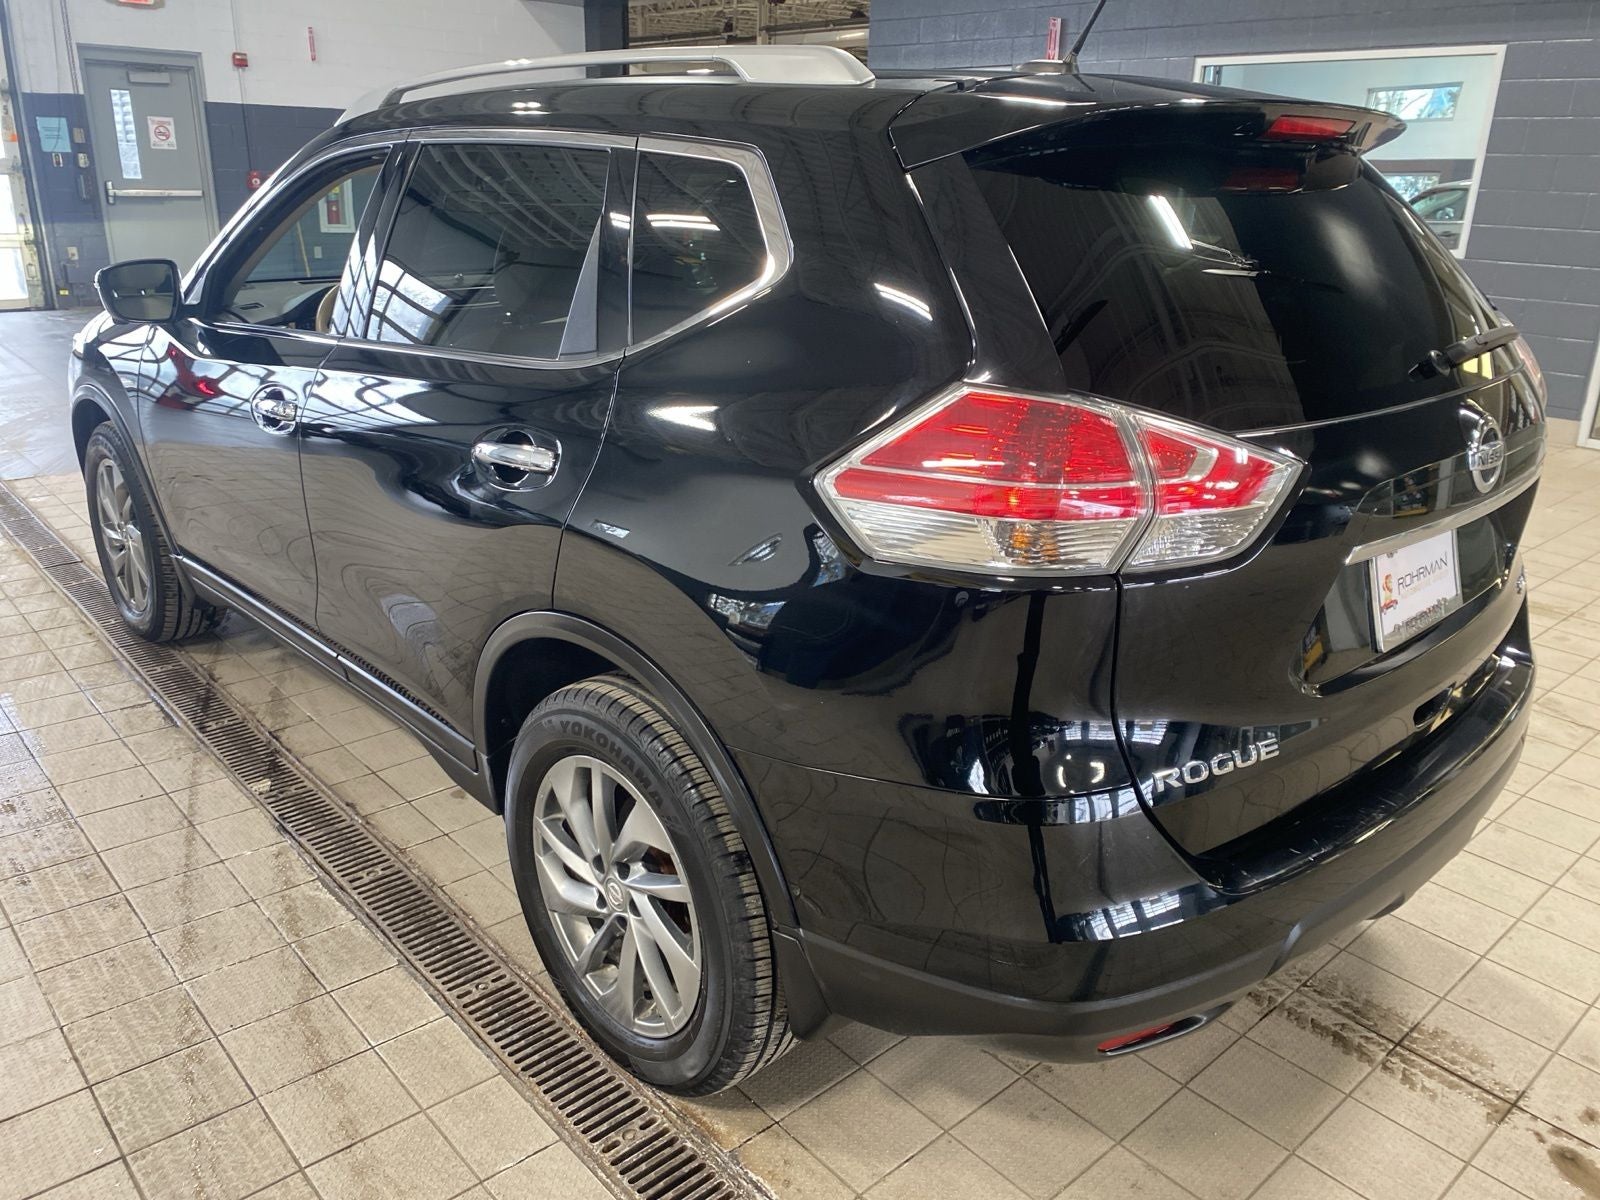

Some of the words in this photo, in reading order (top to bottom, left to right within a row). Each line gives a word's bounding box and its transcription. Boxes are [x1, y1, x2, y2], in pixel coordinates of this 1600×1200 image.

[1397, 551, 1448, 595] ROHRMAN
[559, 719, 664, 810] YOKOHAMA
[1151, 737, 1280, 793] ROGUE
